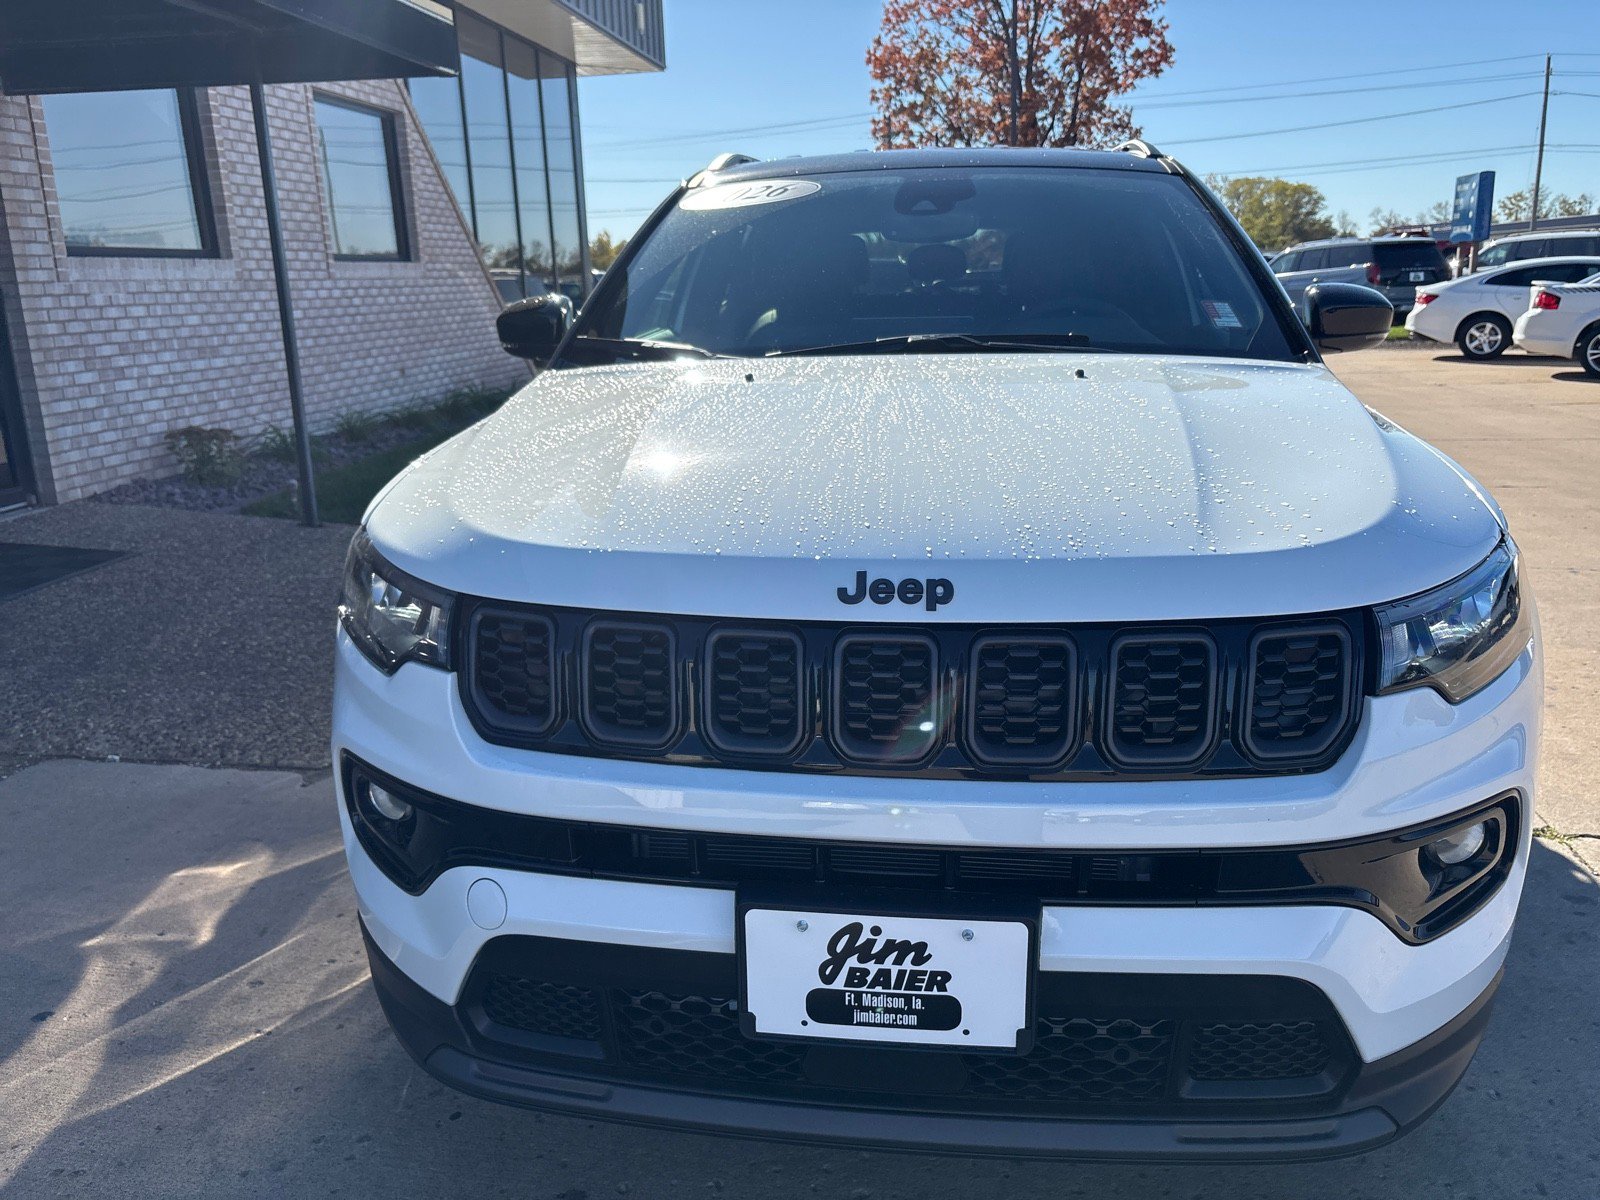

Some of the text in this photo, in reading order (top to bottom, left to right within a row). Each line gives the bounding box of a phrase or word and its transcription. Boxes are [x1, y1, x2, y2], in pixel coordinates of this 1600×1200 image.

[837, 570, 954, 611] Jeep
[818, 921, 932, 985] Jim
[843, 966, 952, 992] BAIER
[845, 992, 858, 1006] Ft.
[862, 993, 908, 1010] Madison,
[853, 1009, 918, 1026] jimbaier.com
